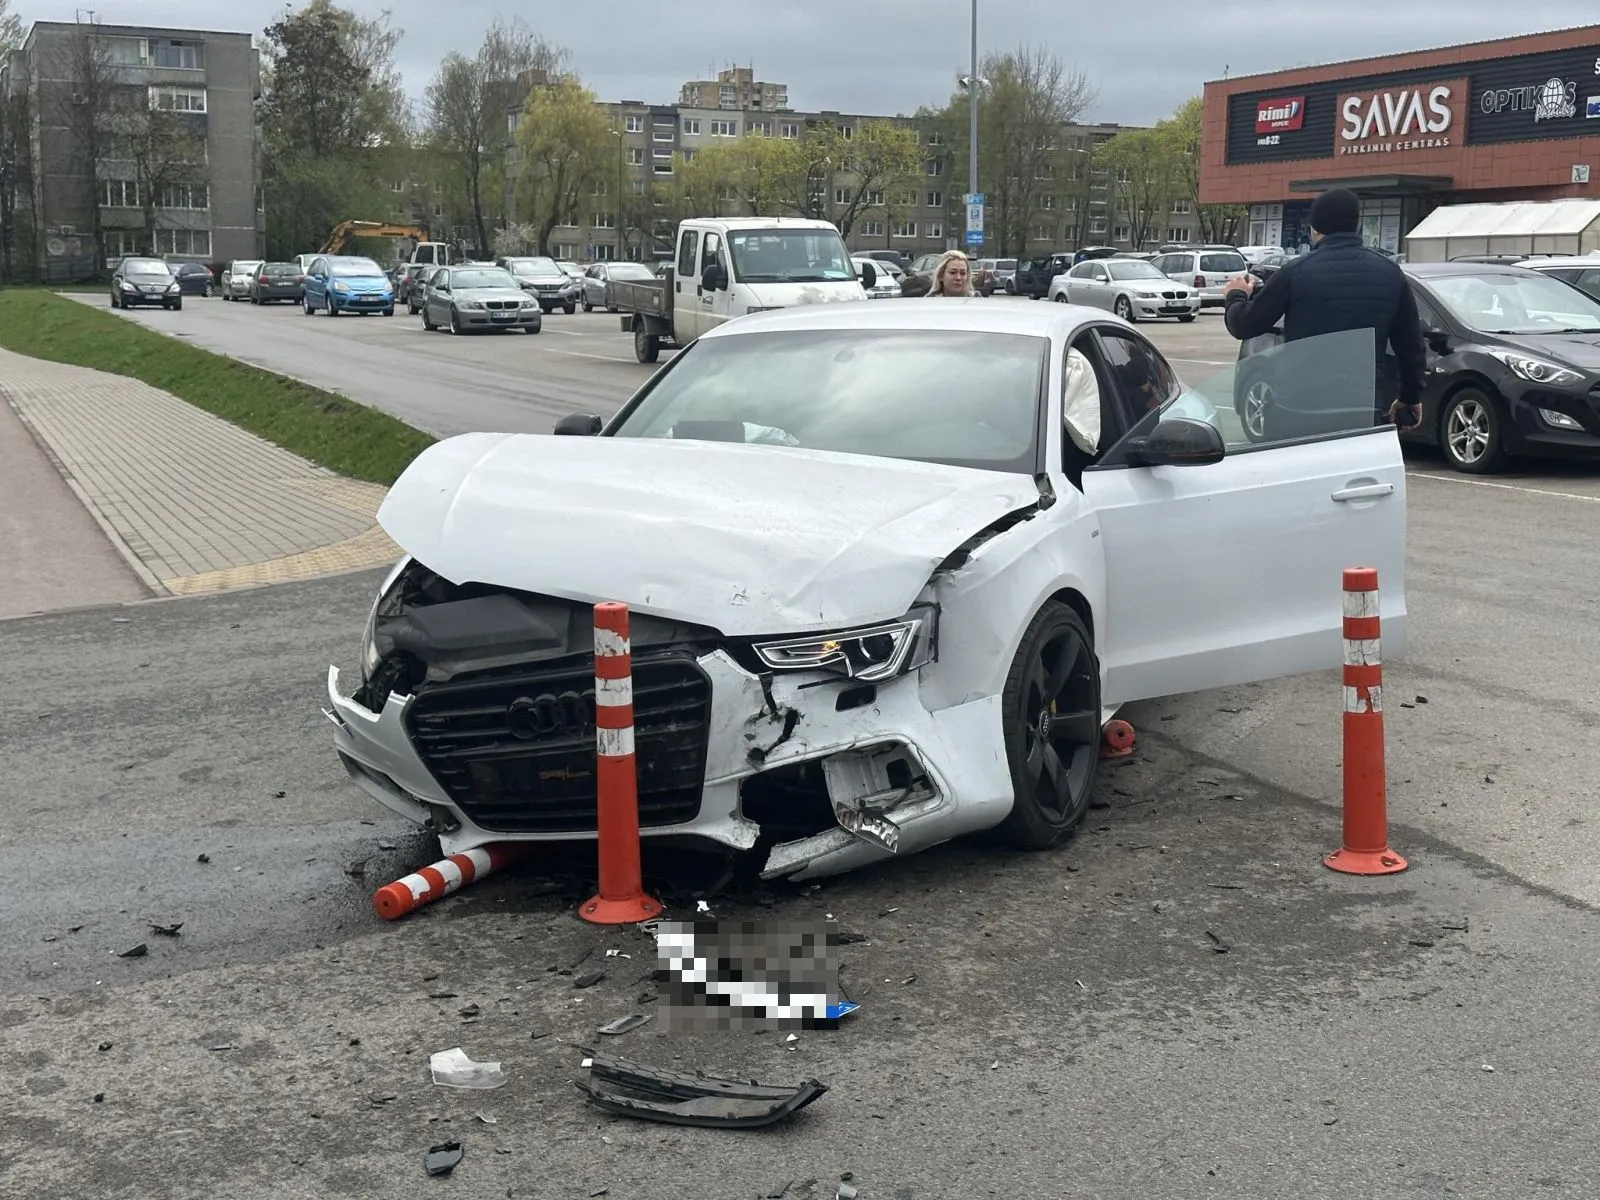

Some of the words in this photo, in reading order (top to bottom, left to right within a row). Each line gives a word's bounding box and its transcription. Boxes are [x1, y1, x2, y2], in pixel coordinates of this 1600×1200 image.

[1258, 104, 1291, 122] Rimi
[1341, 86, 1452, 140] SAVAS
[1340, 143, 1392, 155] PIRKINIŲ
[1396, 138, 1450, 150] CENTRAS
